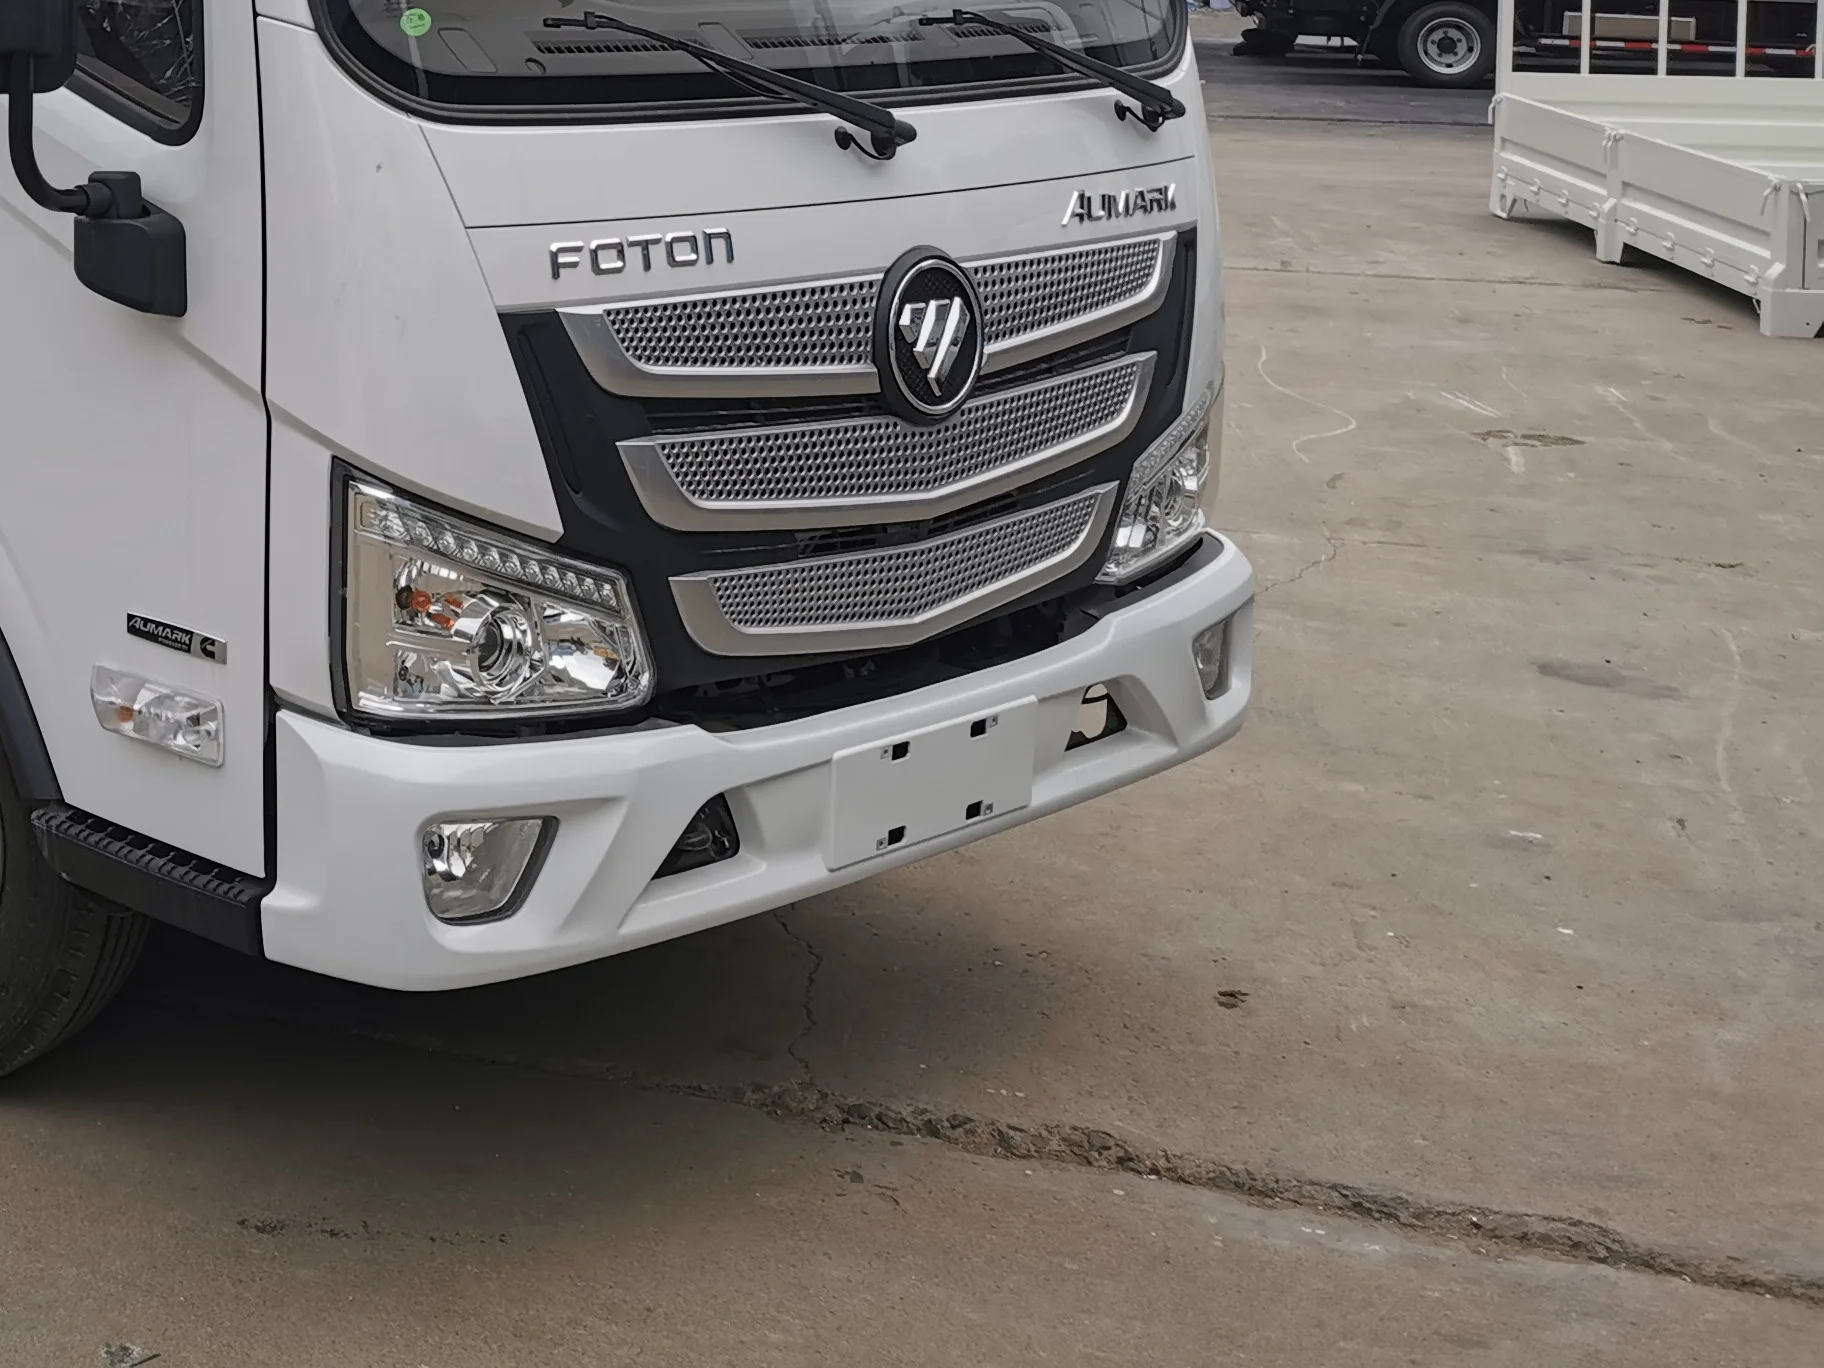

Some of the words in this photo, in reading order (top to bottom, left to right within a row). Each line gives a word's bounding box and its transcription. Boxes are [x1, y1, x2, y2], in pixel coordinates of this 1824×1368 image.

[1061, 183, 1177, 227] AUMARK
[549, 228, 734, 280] FOTON
[128, 616, 192, 644] AUMARK
